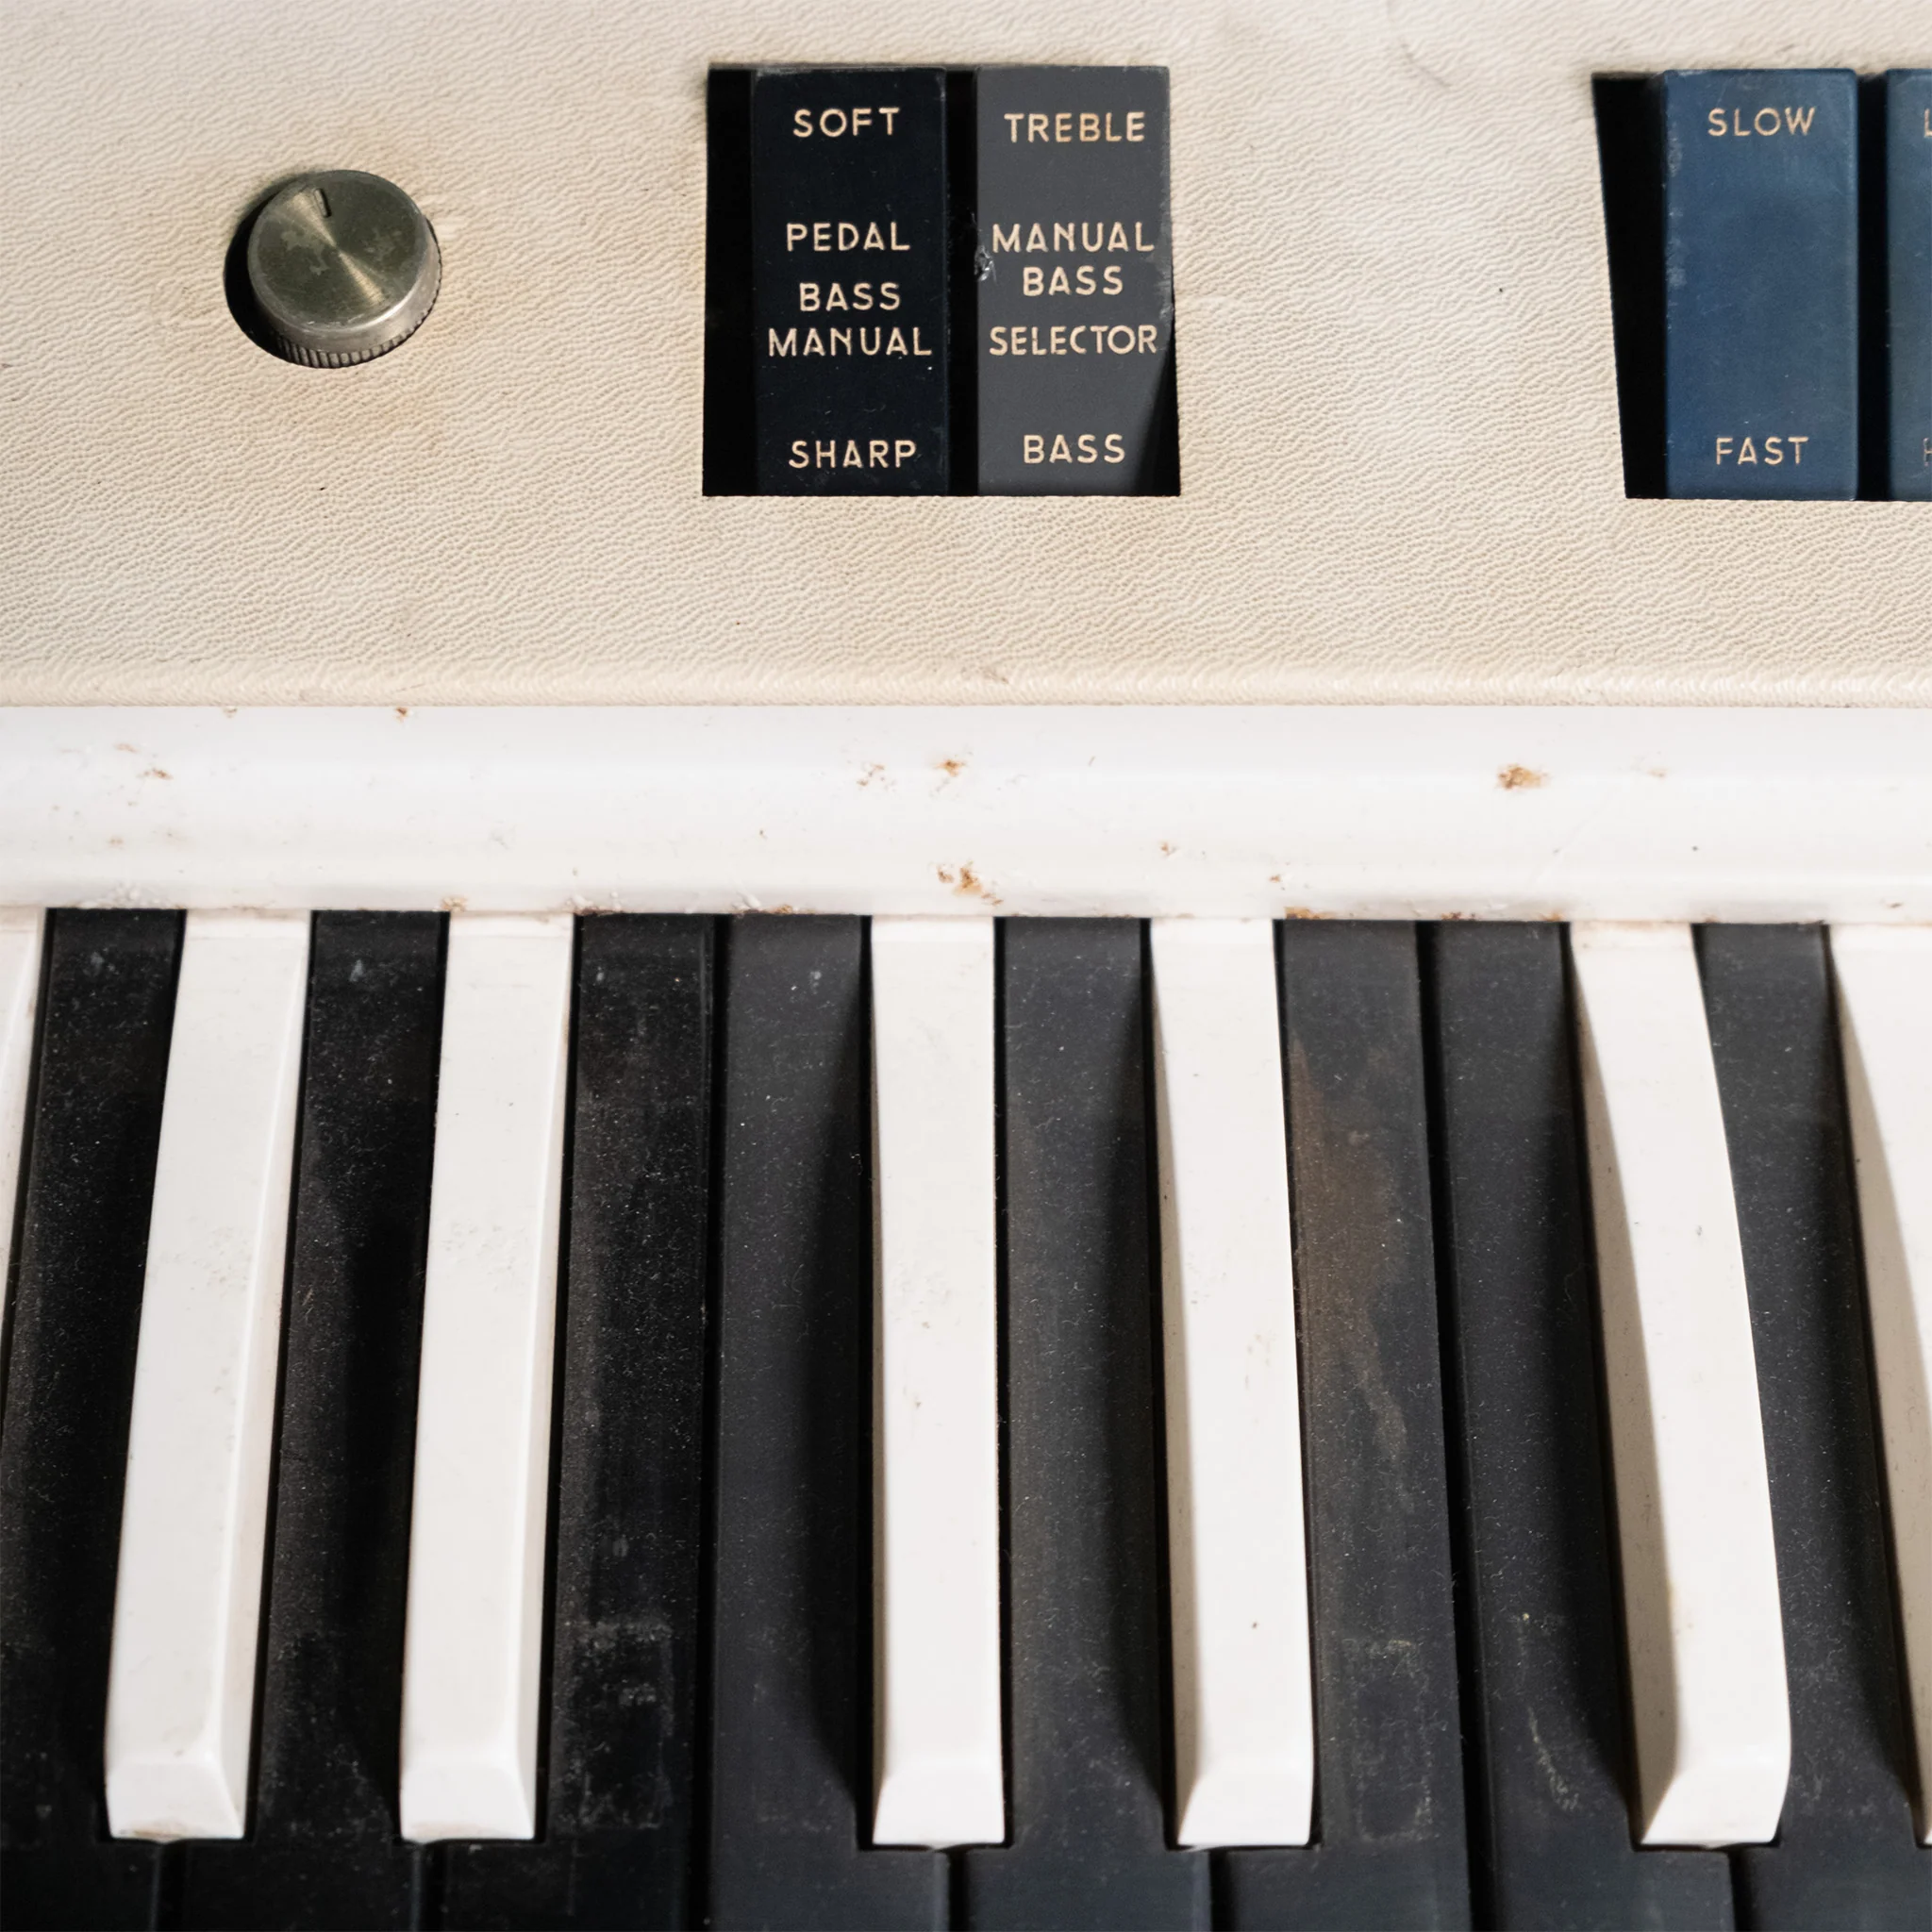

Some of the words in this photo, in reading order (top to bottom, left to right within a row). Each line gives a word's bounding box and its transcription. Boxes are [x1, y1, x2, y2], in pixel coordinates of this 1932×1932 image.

[792, 107, 900, 138] SOFT
[1004, 111, 1145, 143] TREBLE
[1707, 107, 1815, 137] SLOW
[786, 221, 911, 252] PEDAL
[992, 221, 1155, 253] MANUAL
[799, 281, 901, 312] BASS
[1023, 265, 1124, 297] BASS
[768, 326, 933, 358] MANUAL
[989, 325, 1158, 356] SELECTOR
[788, 439, 917, 469] SHARP
[1024, 433, 1125, 464] BASS
[1716, 436, 1809, 465] FAST
